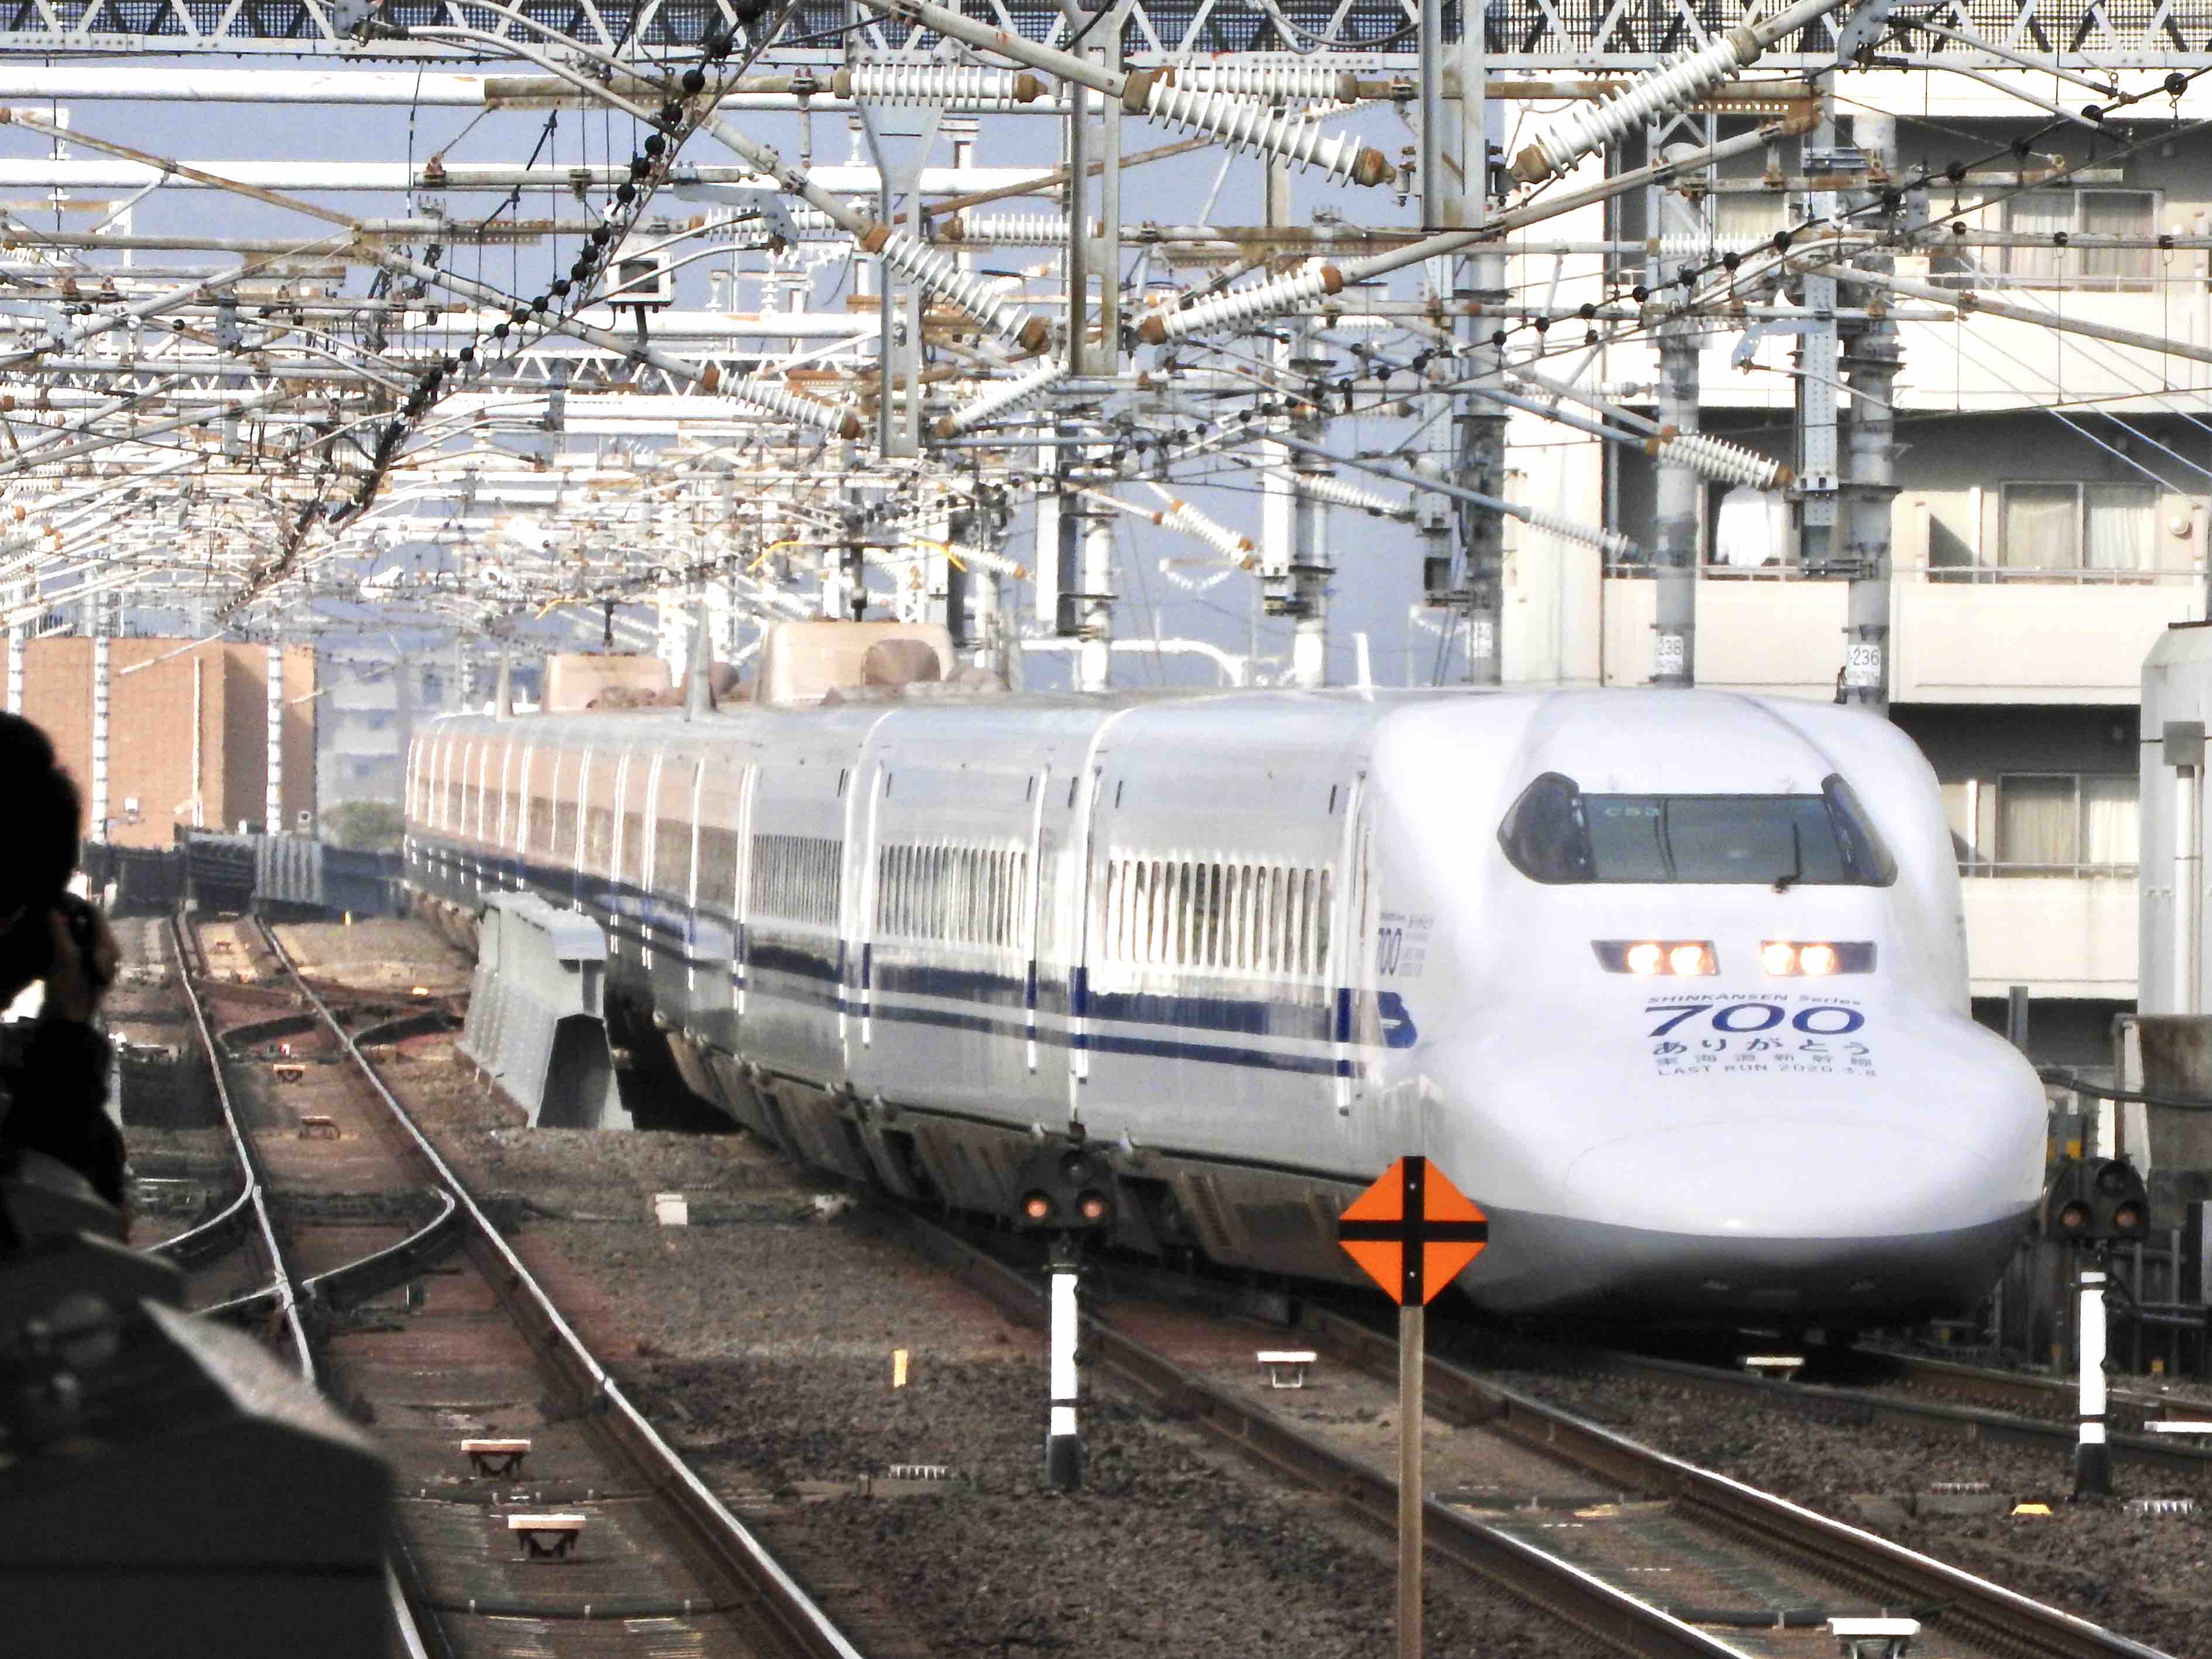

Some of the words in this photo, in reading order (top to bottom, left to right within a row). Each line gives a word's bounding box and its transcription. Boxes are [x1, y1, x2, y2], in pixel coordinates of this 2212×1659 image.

[1648, 994, 1788, 1002] SHINKANSEN
[1799, 995, 1861, 1006] Series
[1644, 1002, 1865, 1038] 700
[1653, 1038, 1870, 1055] ありがとう
[1658, 1066, 1710, 1076] LAST
[1724, 1064, 1767, 1072] RUN
